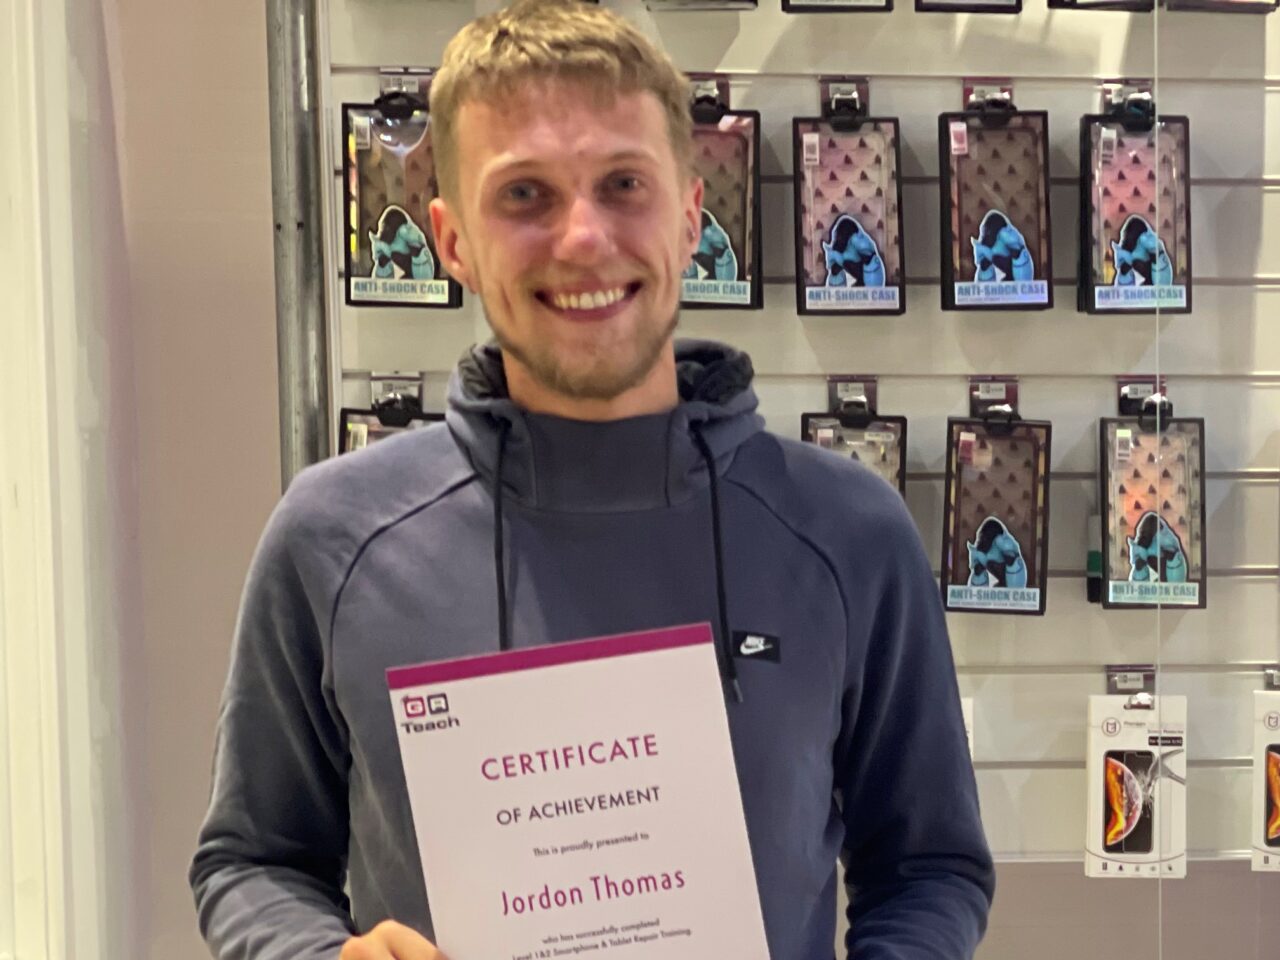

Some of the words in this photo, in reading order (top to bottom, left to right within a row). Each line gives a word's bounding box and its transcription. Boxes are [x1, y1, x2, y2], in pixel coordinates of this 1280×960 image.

[420, 283, 446, 295] CASE
[684, 282, 720, 294] SHOCK
[722, 283, 747, 296] CASE
[871, 290, 896, 300] CASE
[1021, 283, 1045, 294] CASE
[1158, 288, 1183, 299] CASE
[1012, 590, 1037, 602] CASE
[401, 716, 460, 734] Teach
[481, 734, 659, 781] CERTIFICATE
[496, 808, 522, 825] OF
[529, 786, 660, 821] ACHIEVEMENT
[532, 847, 550, 857] This
[551, 846, 559, 854] is
[560, 840, 594, 855] proudly
[596, 833, 638, 850] presented
[640, 832, 650, 841] to
[501, 884, 583, 916] Jordon
[590, 869, 685, 902] Thomas
[542, 935, 559, 944] who
[560, 932, 574, 942] has
[575, 925, 619, 940] successfully
[620, 918, 660, 934] completed
[553, 942, 600, 957] Smartphone
[601, 940, 608, 949] &
[609, 936, 633, 947] Tablet
[634, 932, 659, 945] Repair
[660, 928, 692, 940] Training
